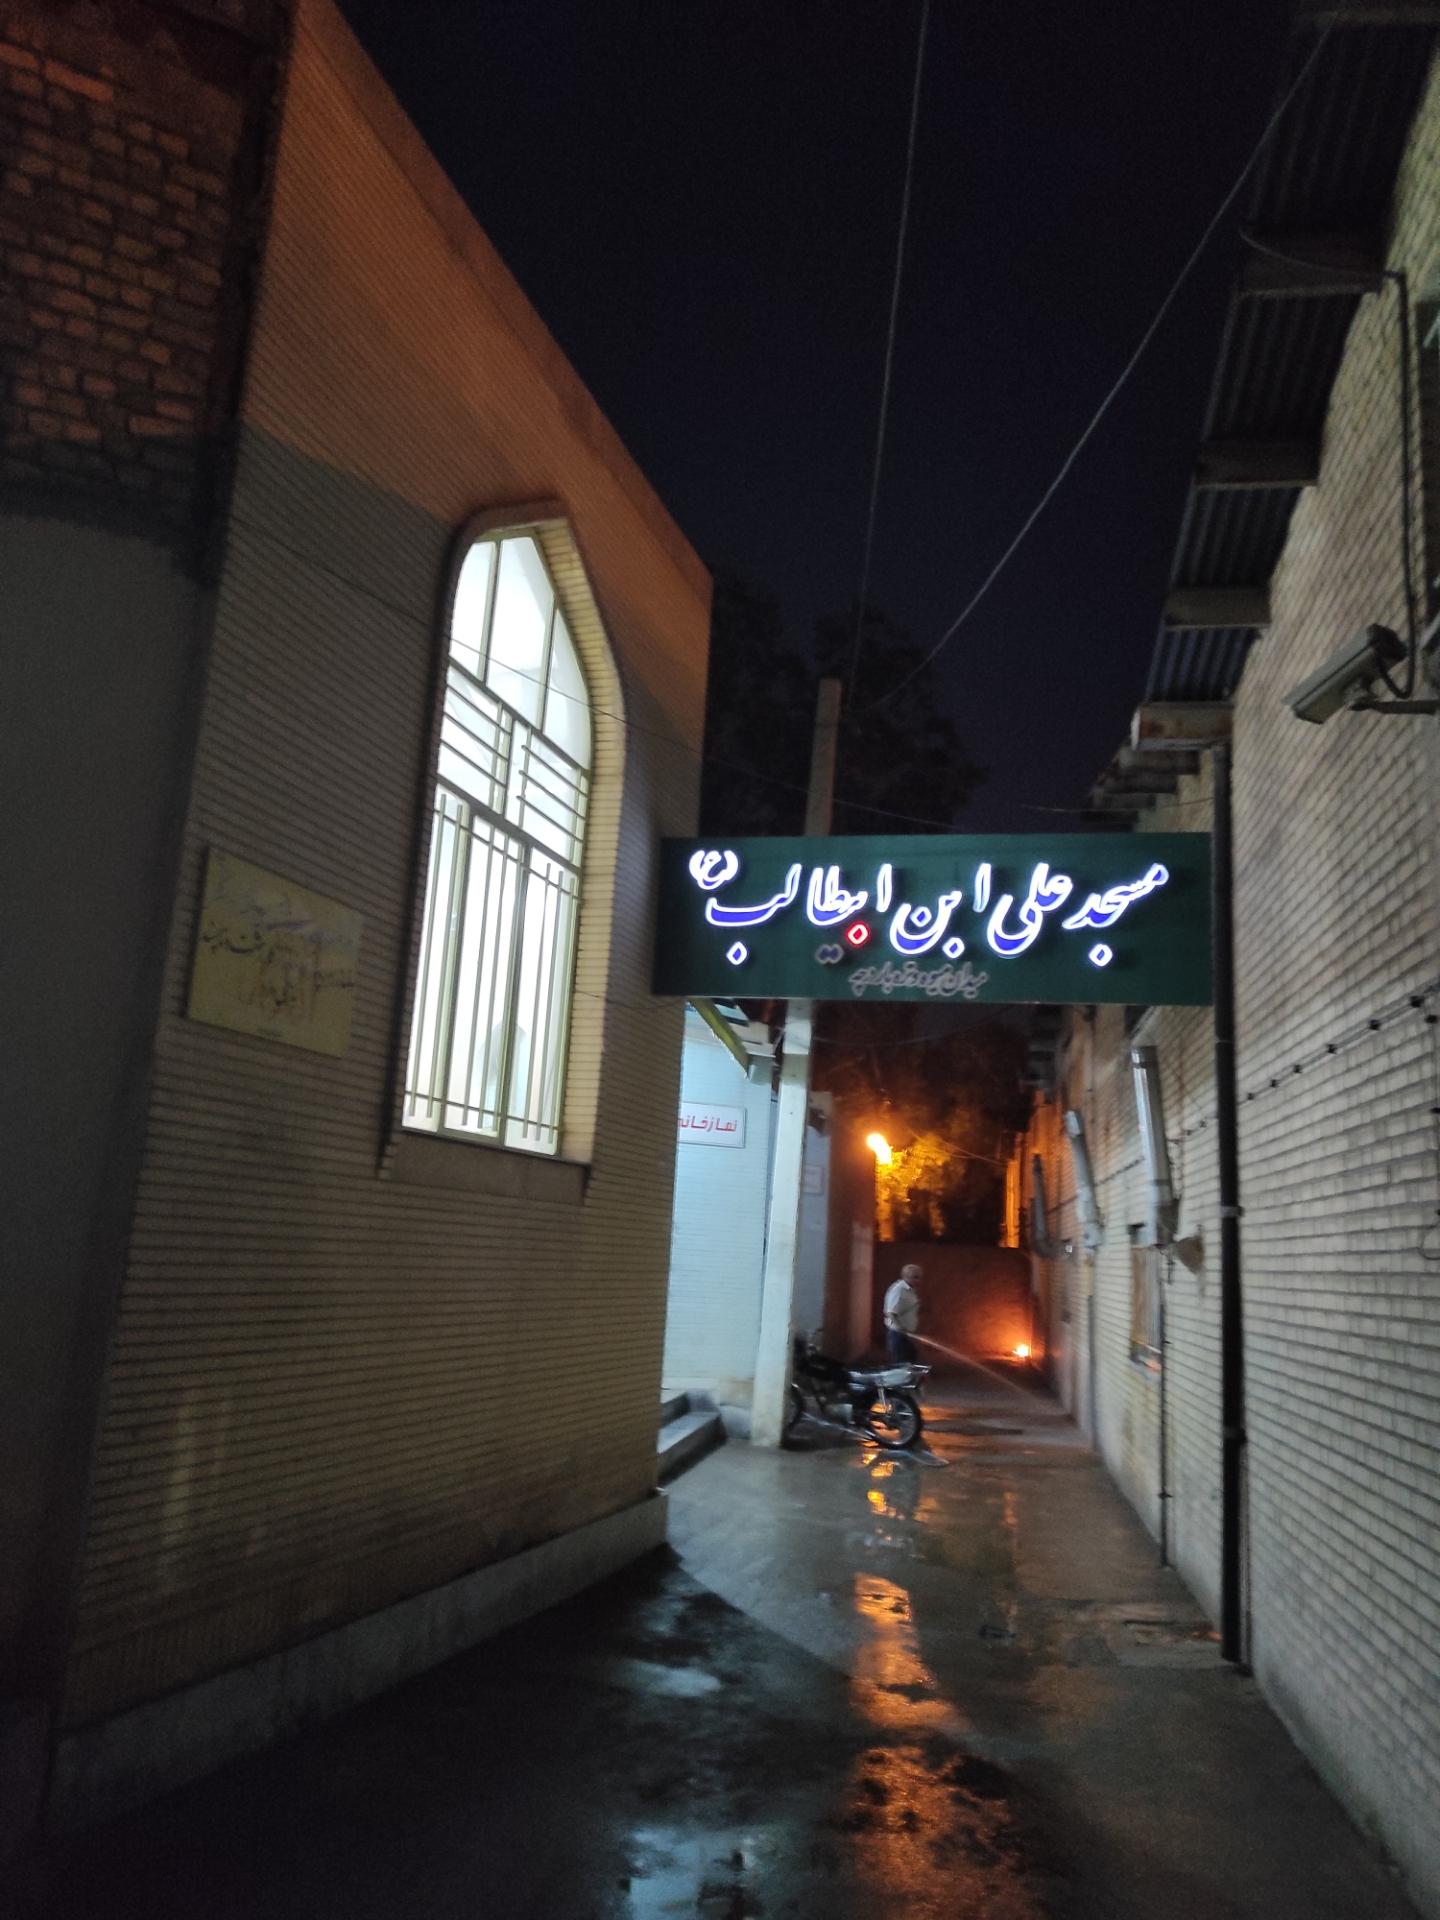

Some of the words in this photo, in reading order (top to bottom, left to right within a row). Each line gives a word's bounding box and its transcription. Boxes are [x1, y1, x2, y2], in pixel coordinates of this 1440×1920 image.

[890, 863, 990, 958] ابن
[988, 863, 1073, 957] علی
[1063, 863, 1169, 966] مسجد
